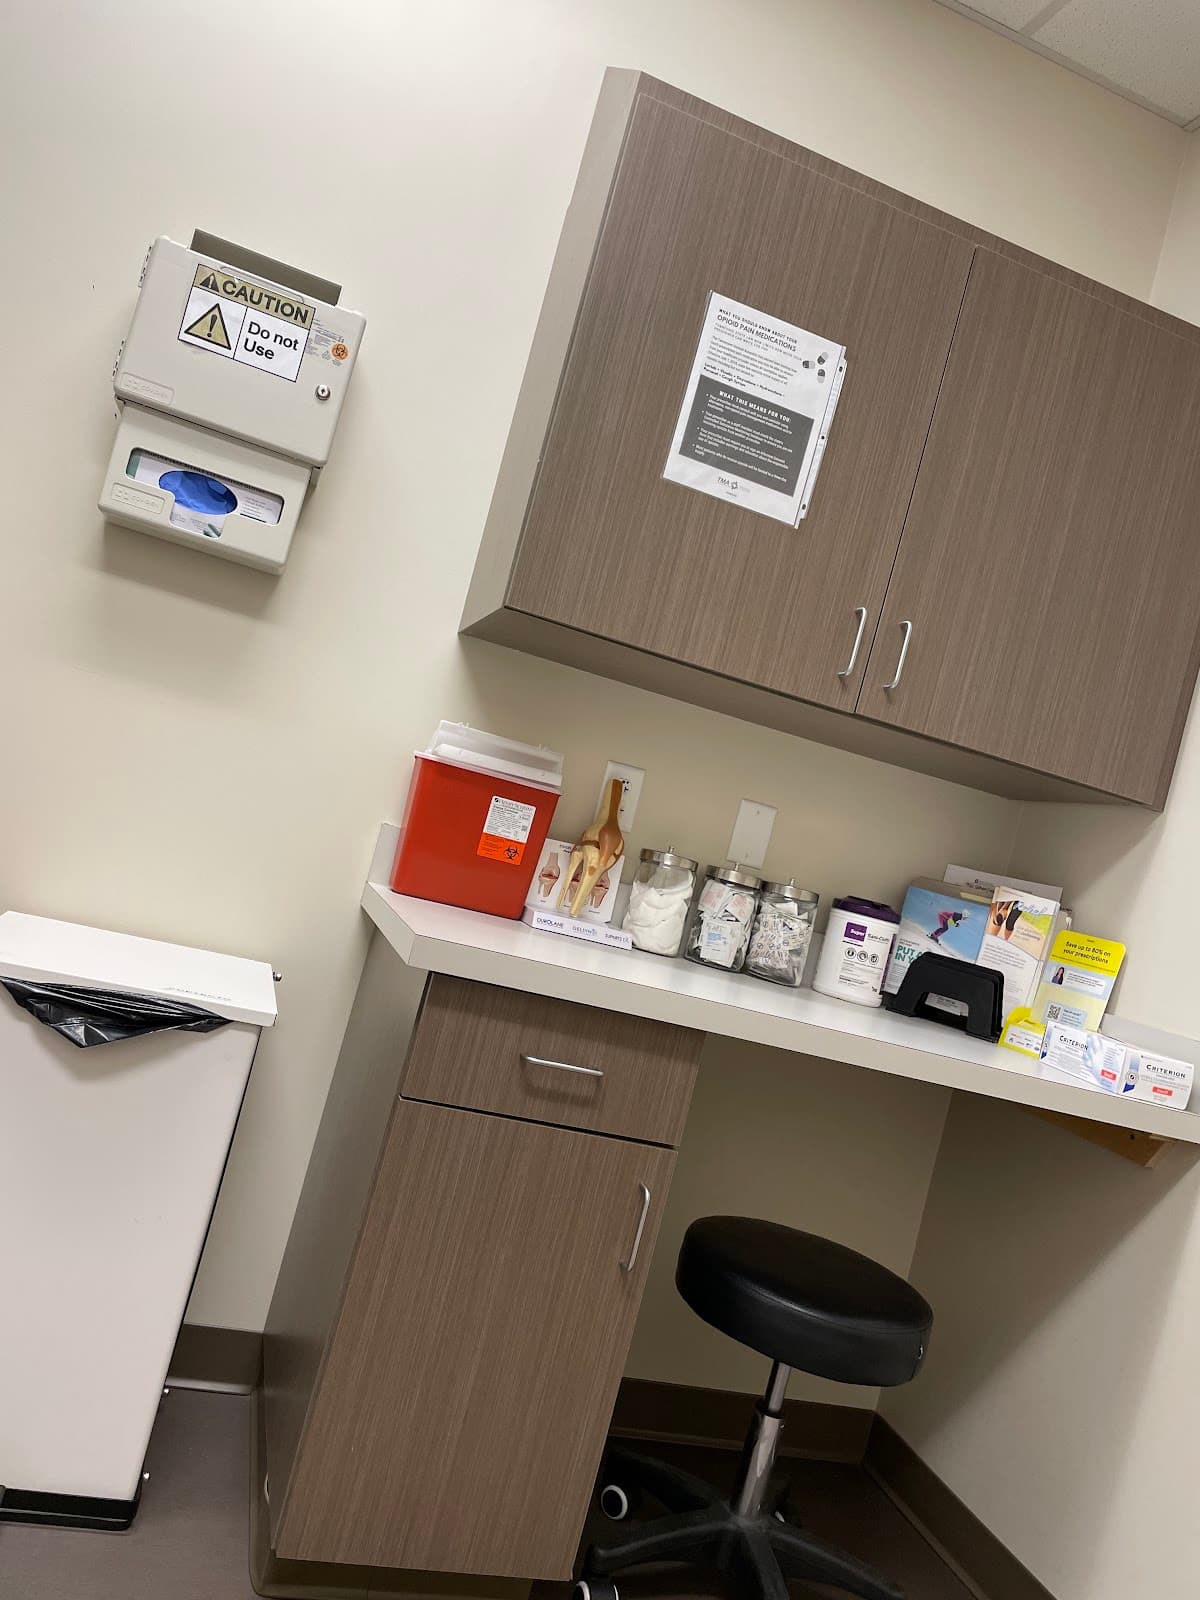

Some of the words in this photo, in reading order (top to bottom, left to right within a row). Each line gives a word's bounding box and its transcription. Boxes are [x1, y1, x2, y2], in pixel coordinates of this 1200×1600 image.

[223, 278, 308, 324] CAUTION
[718, 308, 731, 316] WHAT
[758, 324, 770, 332] KNOW
[771, 330, 784, 338] ABOUT
[248, 321, 270, 341] Do
[273, 332, 299, 352] not
[716, 314, 739, 328] OPIOID
[738, 323, 755, 334] PAIN
[755, 330, 797, 351] MEDICATIONS
[243, 340, 275, 360] Use
[718, 390, 734, 400] WHAT
[734, 396, 748, 406] THIS
[748, 401, 767, 413] MEANS
[767, 409, 778, 417] FOR
[849, 928, 864, 937] Super
[894, 952, 905, 961] IN
[896, 944, 915, 955] PUT
[1074, 951, 1108, 963] prescriptions
[1059, 1035, 1089, 1050] CRITERION
[1146, 1064, 1186, 1078] CRITERION
